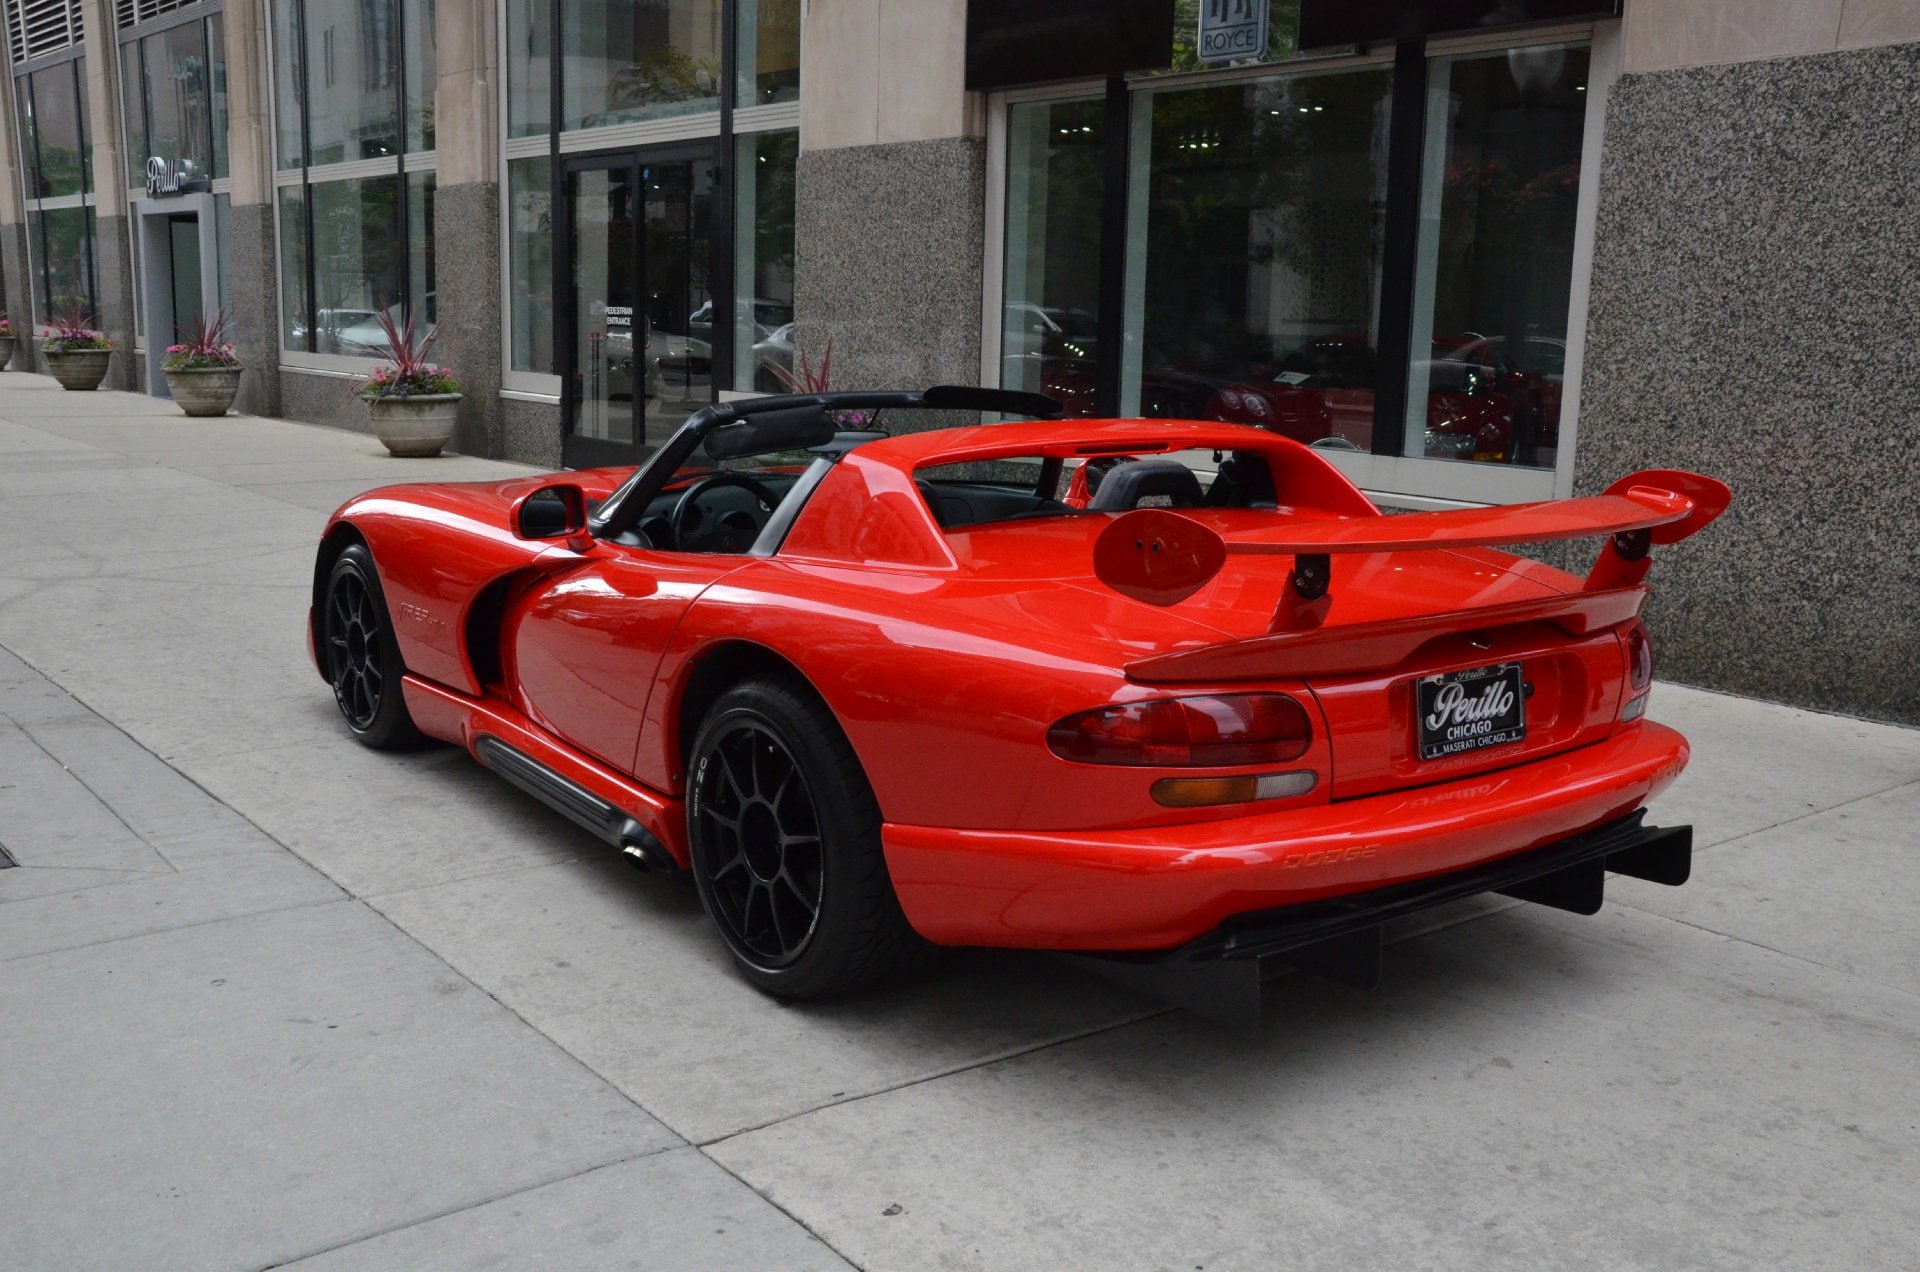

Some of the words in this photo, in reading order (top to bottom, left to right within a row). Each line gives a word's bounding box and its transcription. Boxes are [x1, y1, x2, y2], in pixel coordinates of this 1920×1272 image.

[1204, 28, 1255, 52] ROYCE
[146, 156, 180, 194] Perillo
[605, 306, 633, 315] PEDESTRIAN
[606, 316, 631, 326] ENTRANCE
[1426, 680, 1514, 731] Perillo
[1447, 720, 1492, 740] CHICAGO
[1443, 739, 1476, 753] MASERATI
[1477, 732, 1507, 747] CHICAGO
[1282, 844, 1381, 870] DODGE
